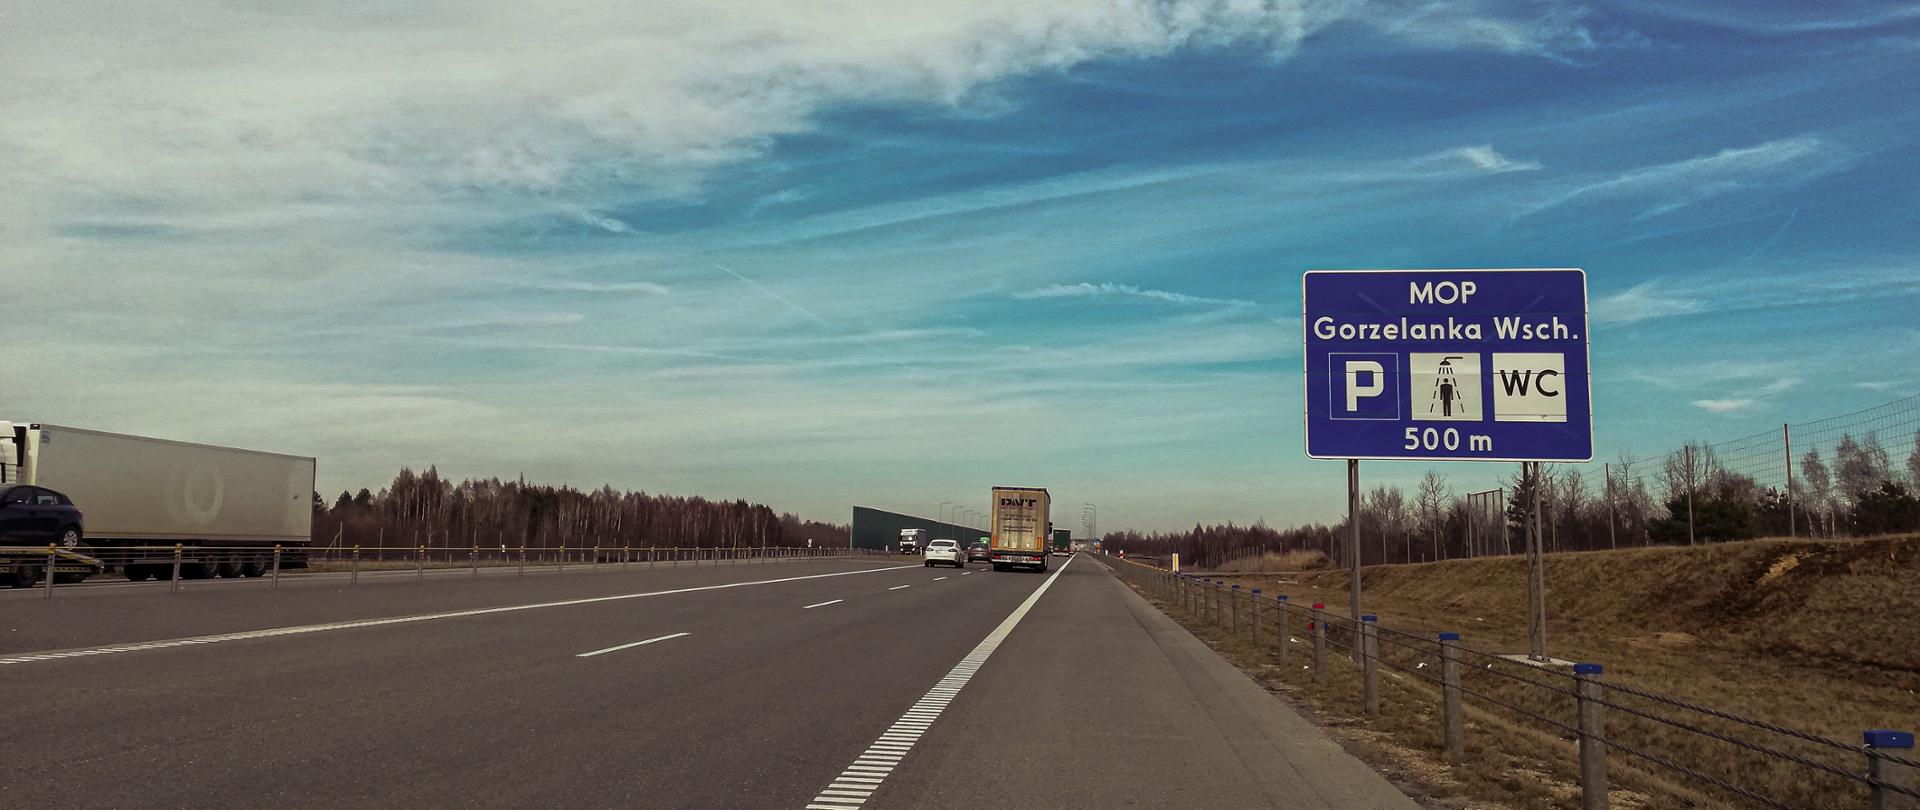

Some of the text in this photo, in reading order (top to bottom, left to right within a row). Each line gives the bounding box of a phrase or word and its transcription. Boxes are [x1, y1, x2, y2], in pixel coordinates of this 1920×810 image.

[1409, 281, 1477, 305] MOP
[1313, 316, 1580, 340] Gorzelanka Wsch.
[1345, 360, 1385, 413] P
[1499, 369, 1560, 397] WC
[1404, 427, 1493, 452] 500 m
